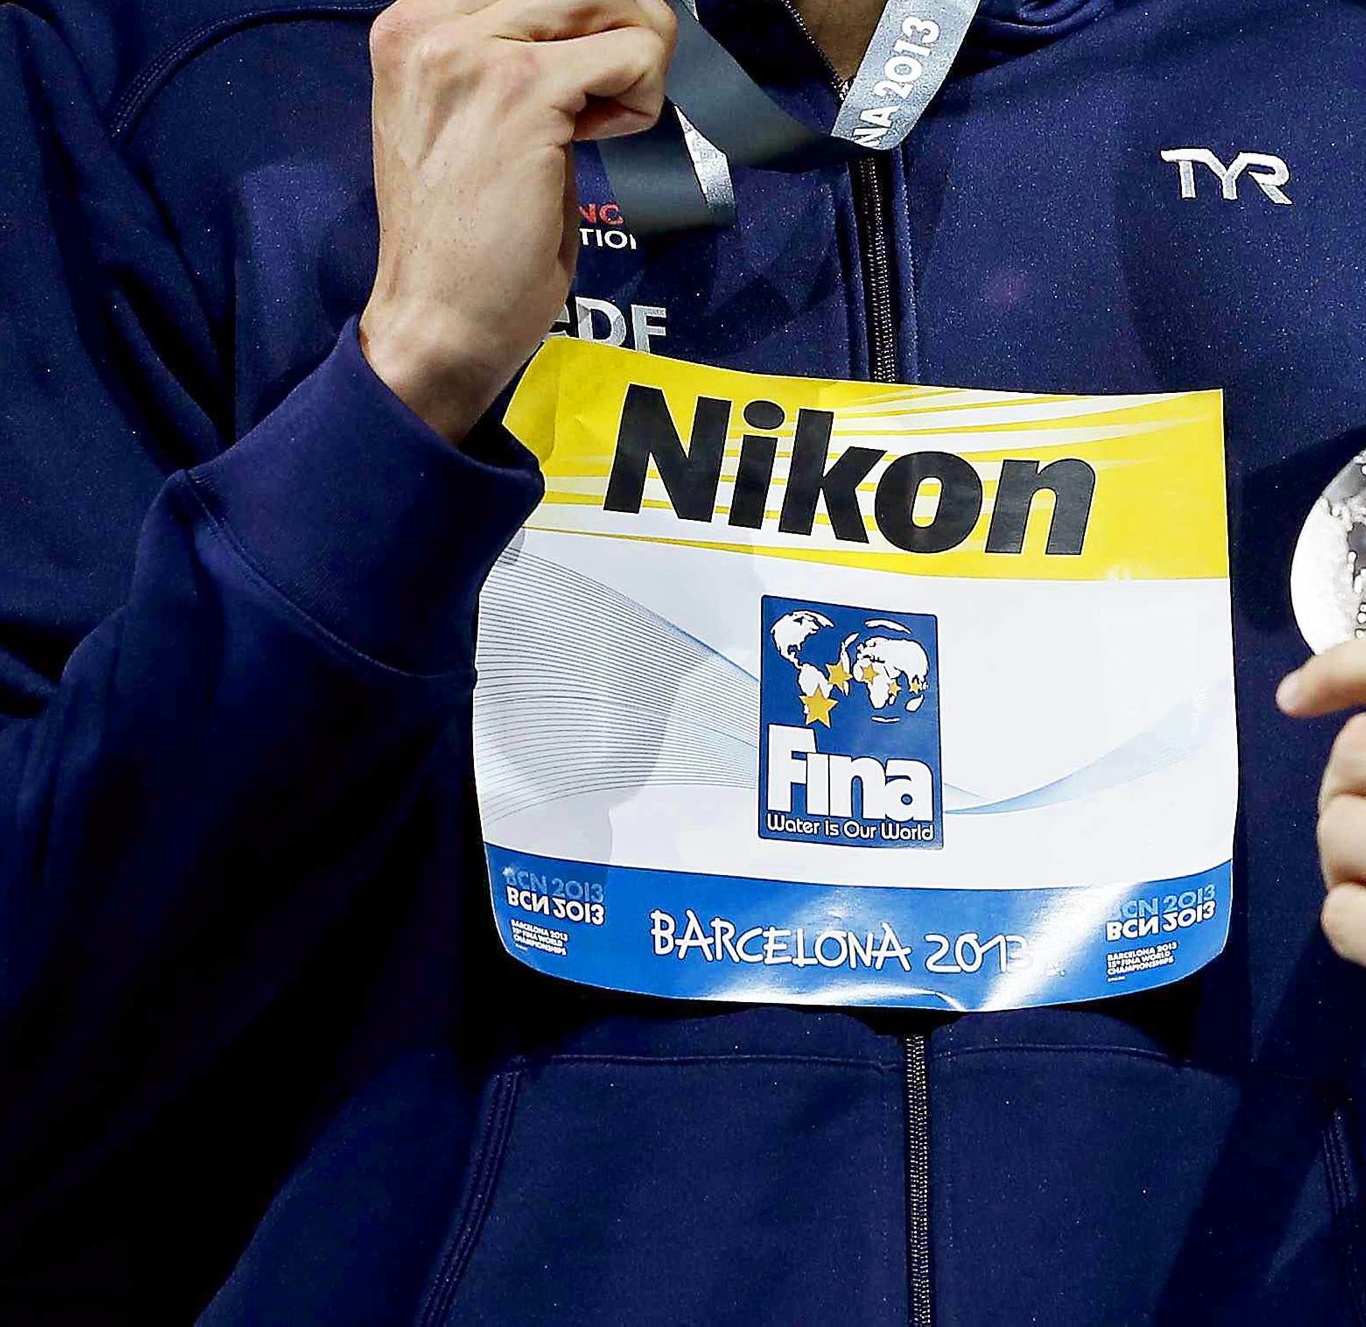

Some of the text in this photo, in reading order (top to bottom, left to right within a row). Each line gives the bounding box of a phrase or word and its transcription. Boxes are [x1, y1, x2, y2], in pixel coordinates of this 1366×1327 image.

[874, 15, 940, 101] 2013
[1159, 147, 1294, 206] TYR
[602, 382, 1097, 556] Nikon
[767, 723, 934, 822] Fina
[766, 813, 821, 835] Water
[843, 821, 877, 839] Our
[881, 823, 934, 841] World
[649, 908, 1032, 974] BARCELONA 2013
